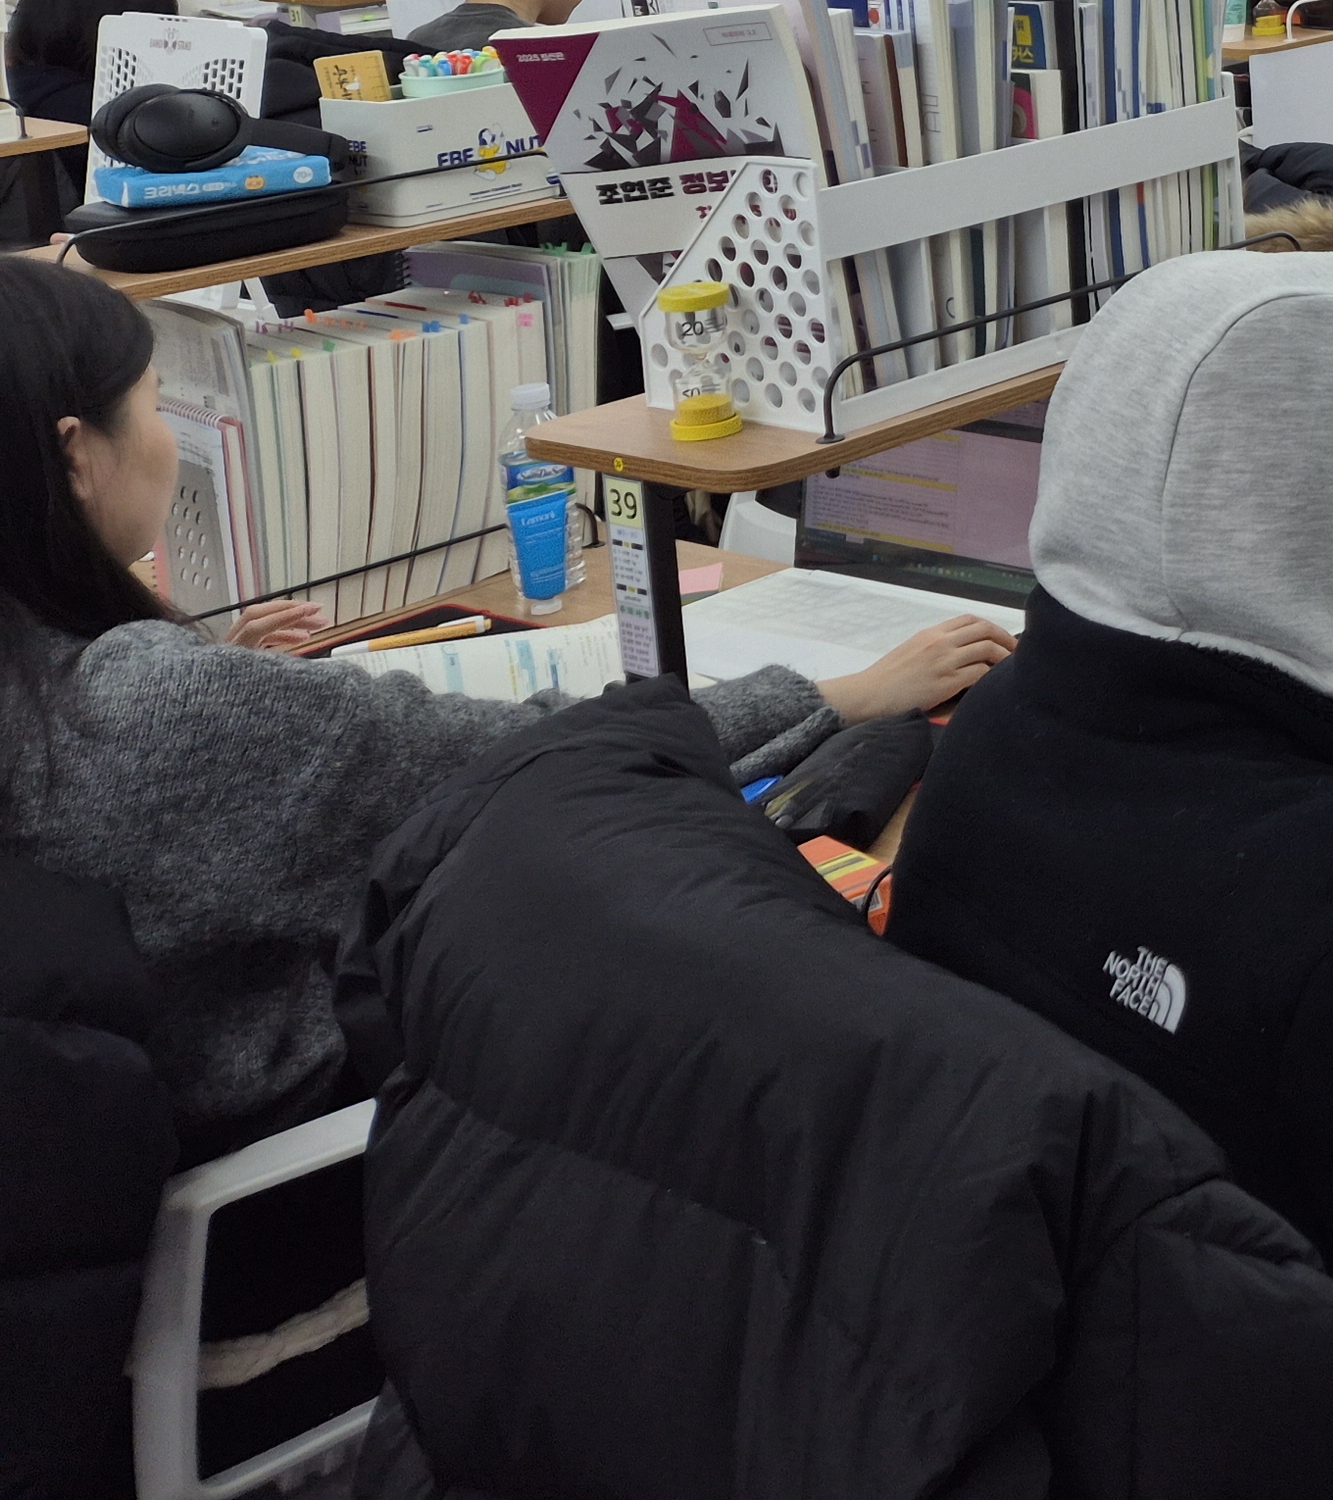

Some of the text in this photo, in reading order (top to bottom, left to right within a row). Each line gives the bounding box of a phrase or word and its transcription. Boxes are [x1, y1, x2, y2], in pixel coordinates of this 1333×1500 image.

[291, 10, 300, 22] 31
[596, 176, 675, 205] 조현준
[682, 321, 704, 336] 20
[609, 488, 638, 520] 39
[1102, 950, 1161, 999] NORTH
[1137, 946, 1168, 977] THE
[1109, 978, 1153, 1017] FACE
